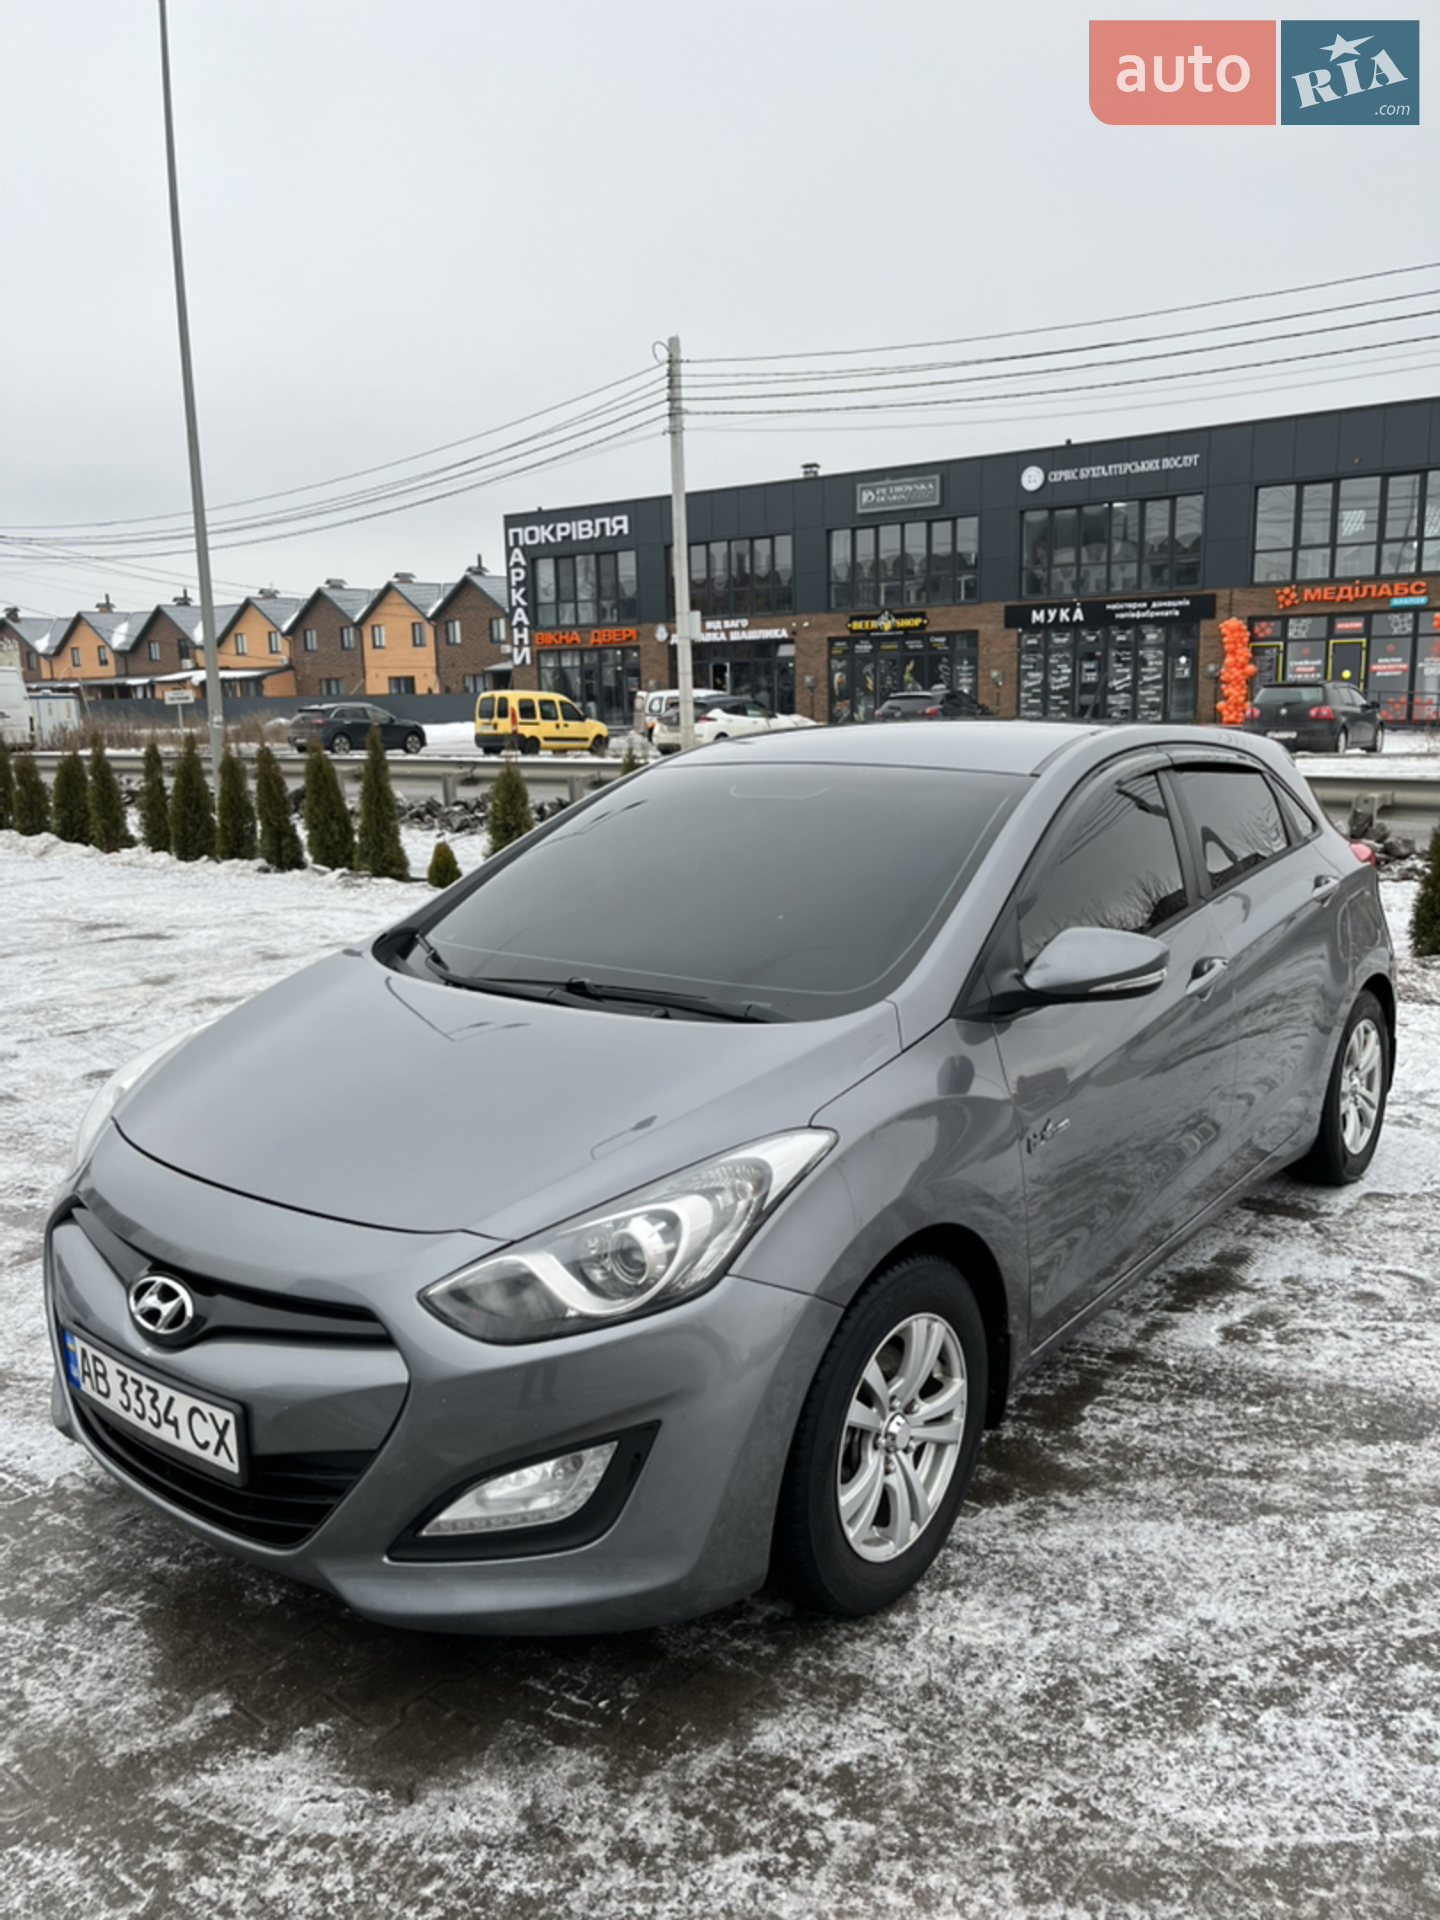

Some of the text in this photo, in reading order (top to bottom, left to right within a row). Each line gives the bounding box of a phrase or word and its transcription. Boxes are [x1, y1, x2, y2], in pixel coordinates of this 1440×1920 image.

[1161, 453, 1200, 471] ПОСЛУГ
[508, 514, 629, 547] ПОКРІВЛЯ
[533, 628, 638, 647] ВІКНА ДВЕРІ
[80, 1346, 236, 1465] AB 3334 CX
